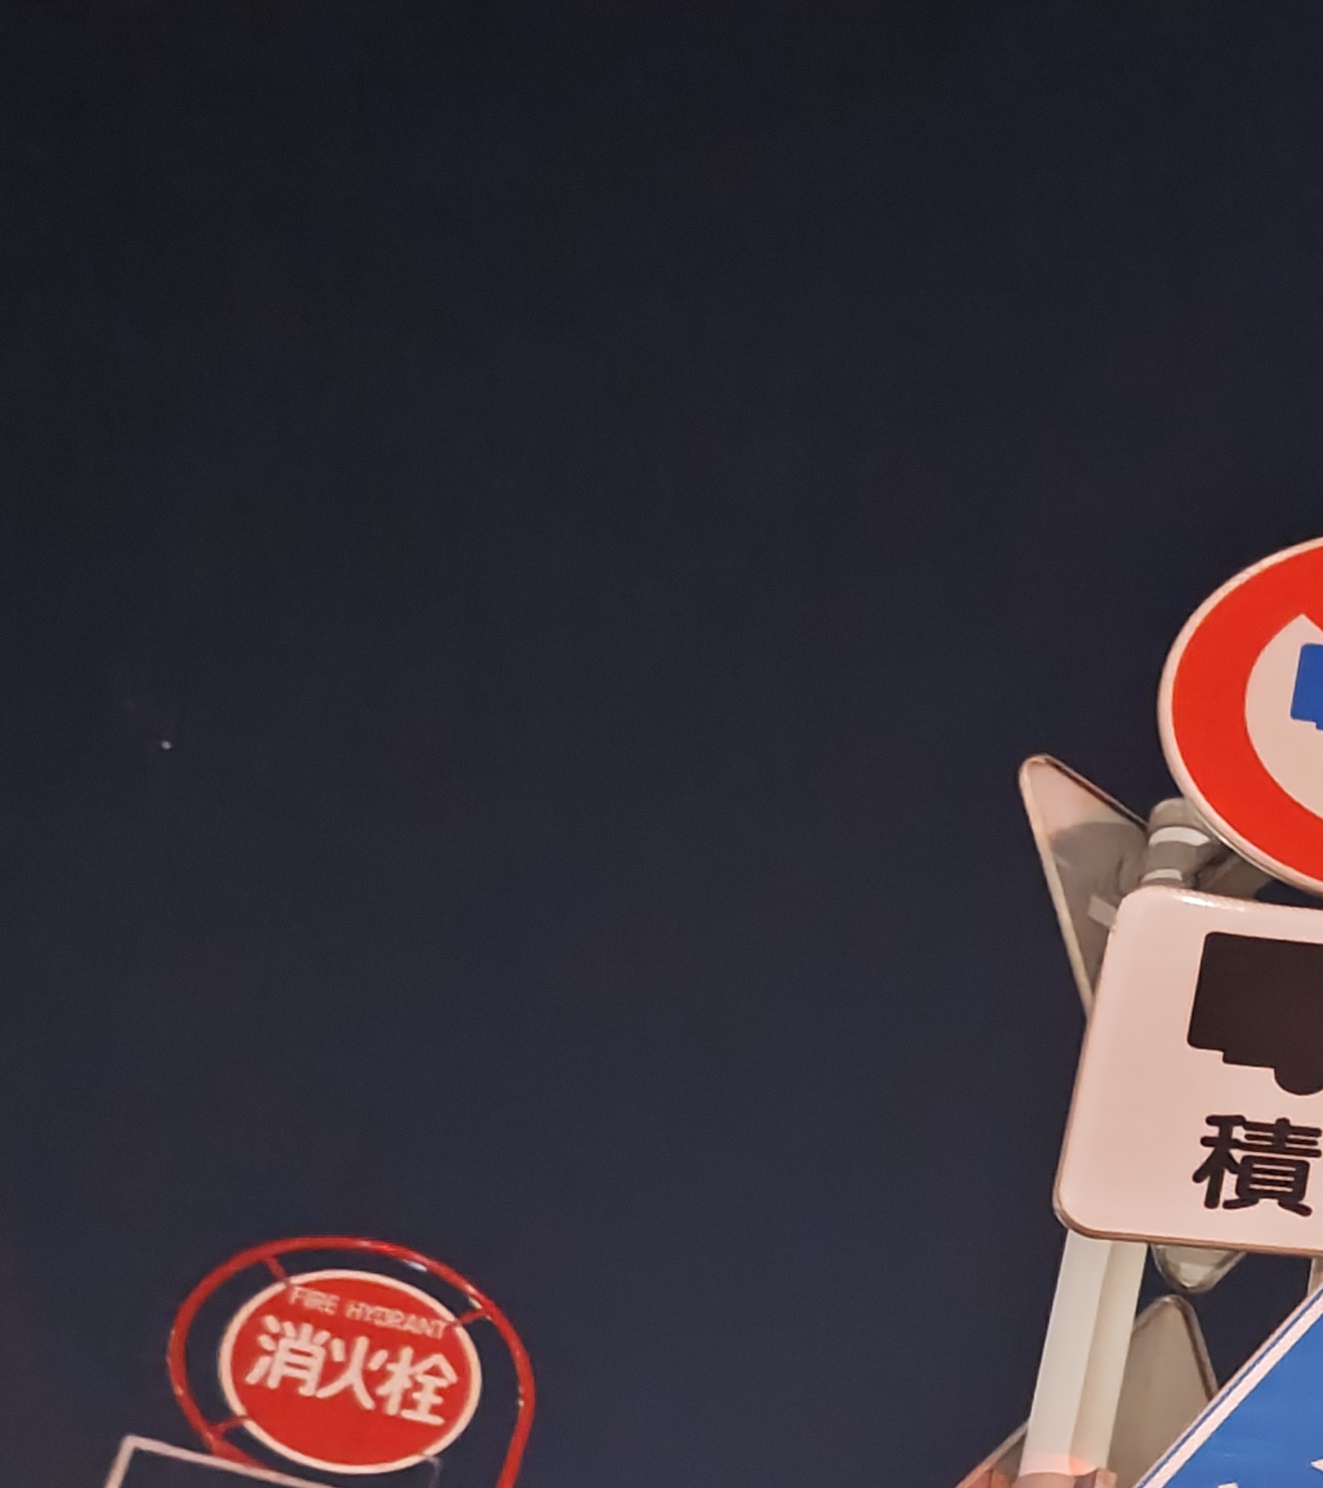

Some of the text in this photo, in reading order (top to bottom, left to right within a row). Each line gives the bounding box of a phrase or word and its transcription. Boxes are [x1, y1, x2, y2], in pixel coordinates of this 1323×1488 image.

[290, 1286, 447, 1340] FIRE HYDRANT
[245, 1314, 459, 1426] 消火栓
